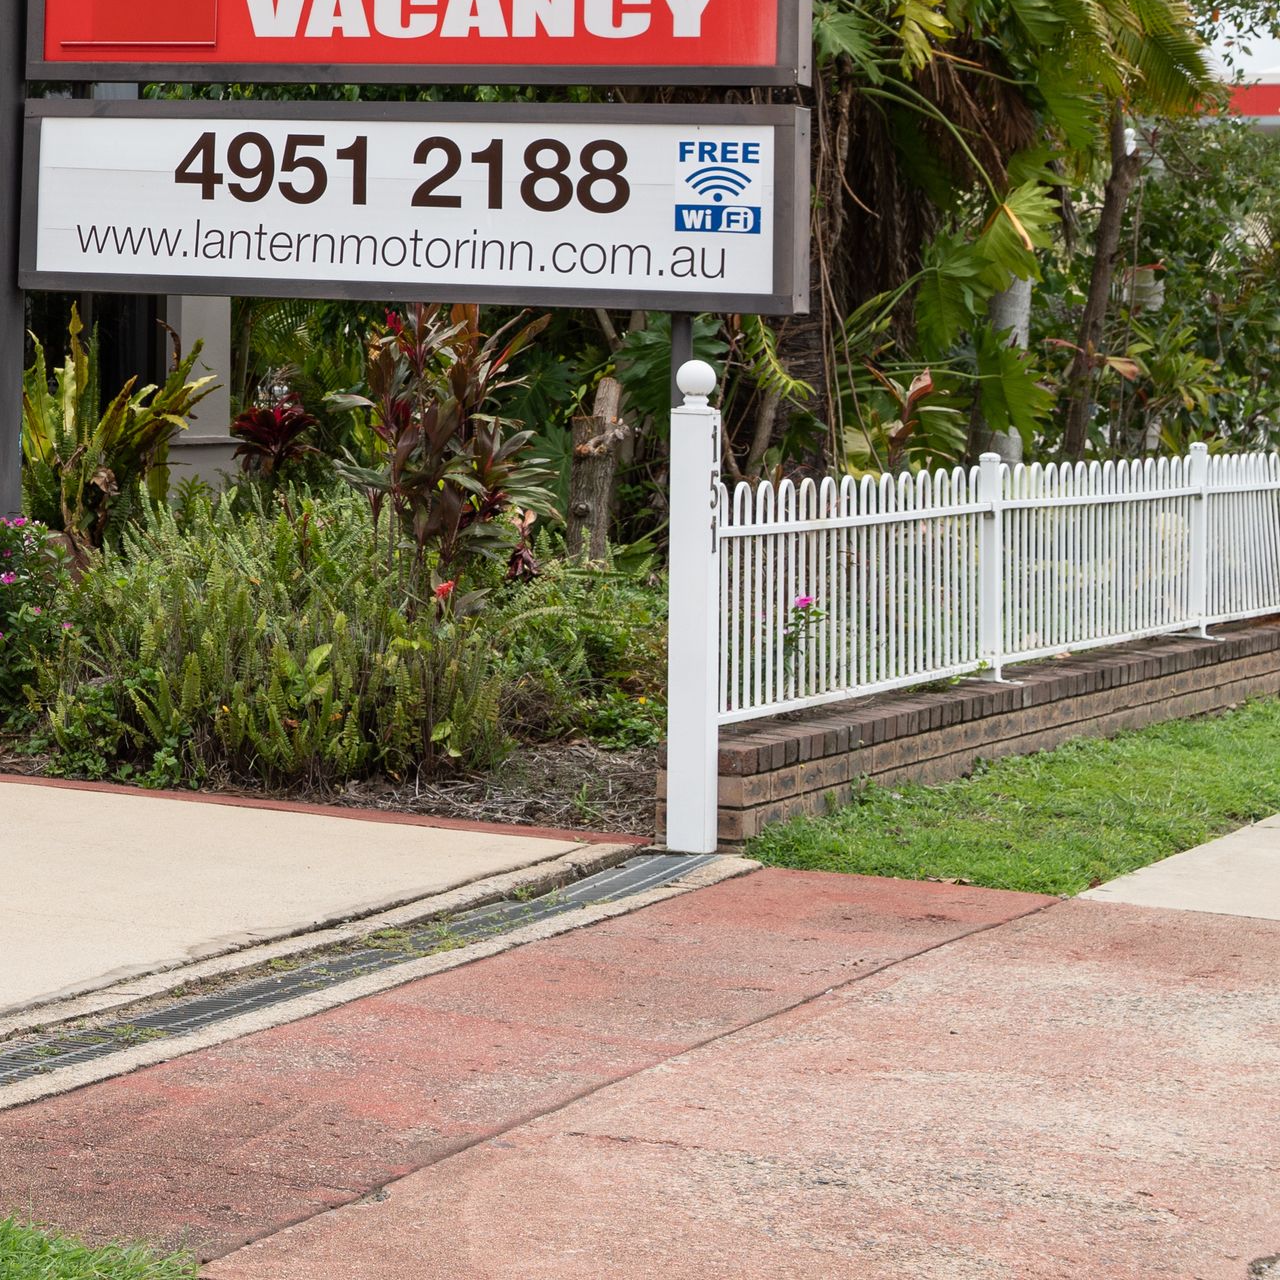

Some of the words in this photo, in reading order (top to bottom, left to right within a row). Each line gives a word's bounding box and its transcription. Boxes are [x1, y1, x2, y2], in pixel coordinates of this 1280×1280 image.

[174, 131, 368, 206] 4951
[410, 136, 631, 214] 2188
[679, 141, 760, 164] FREE
[76, 219, 726, 279] www.lanternmotorinn.com.au
[709, 424, 720, 553] 151
